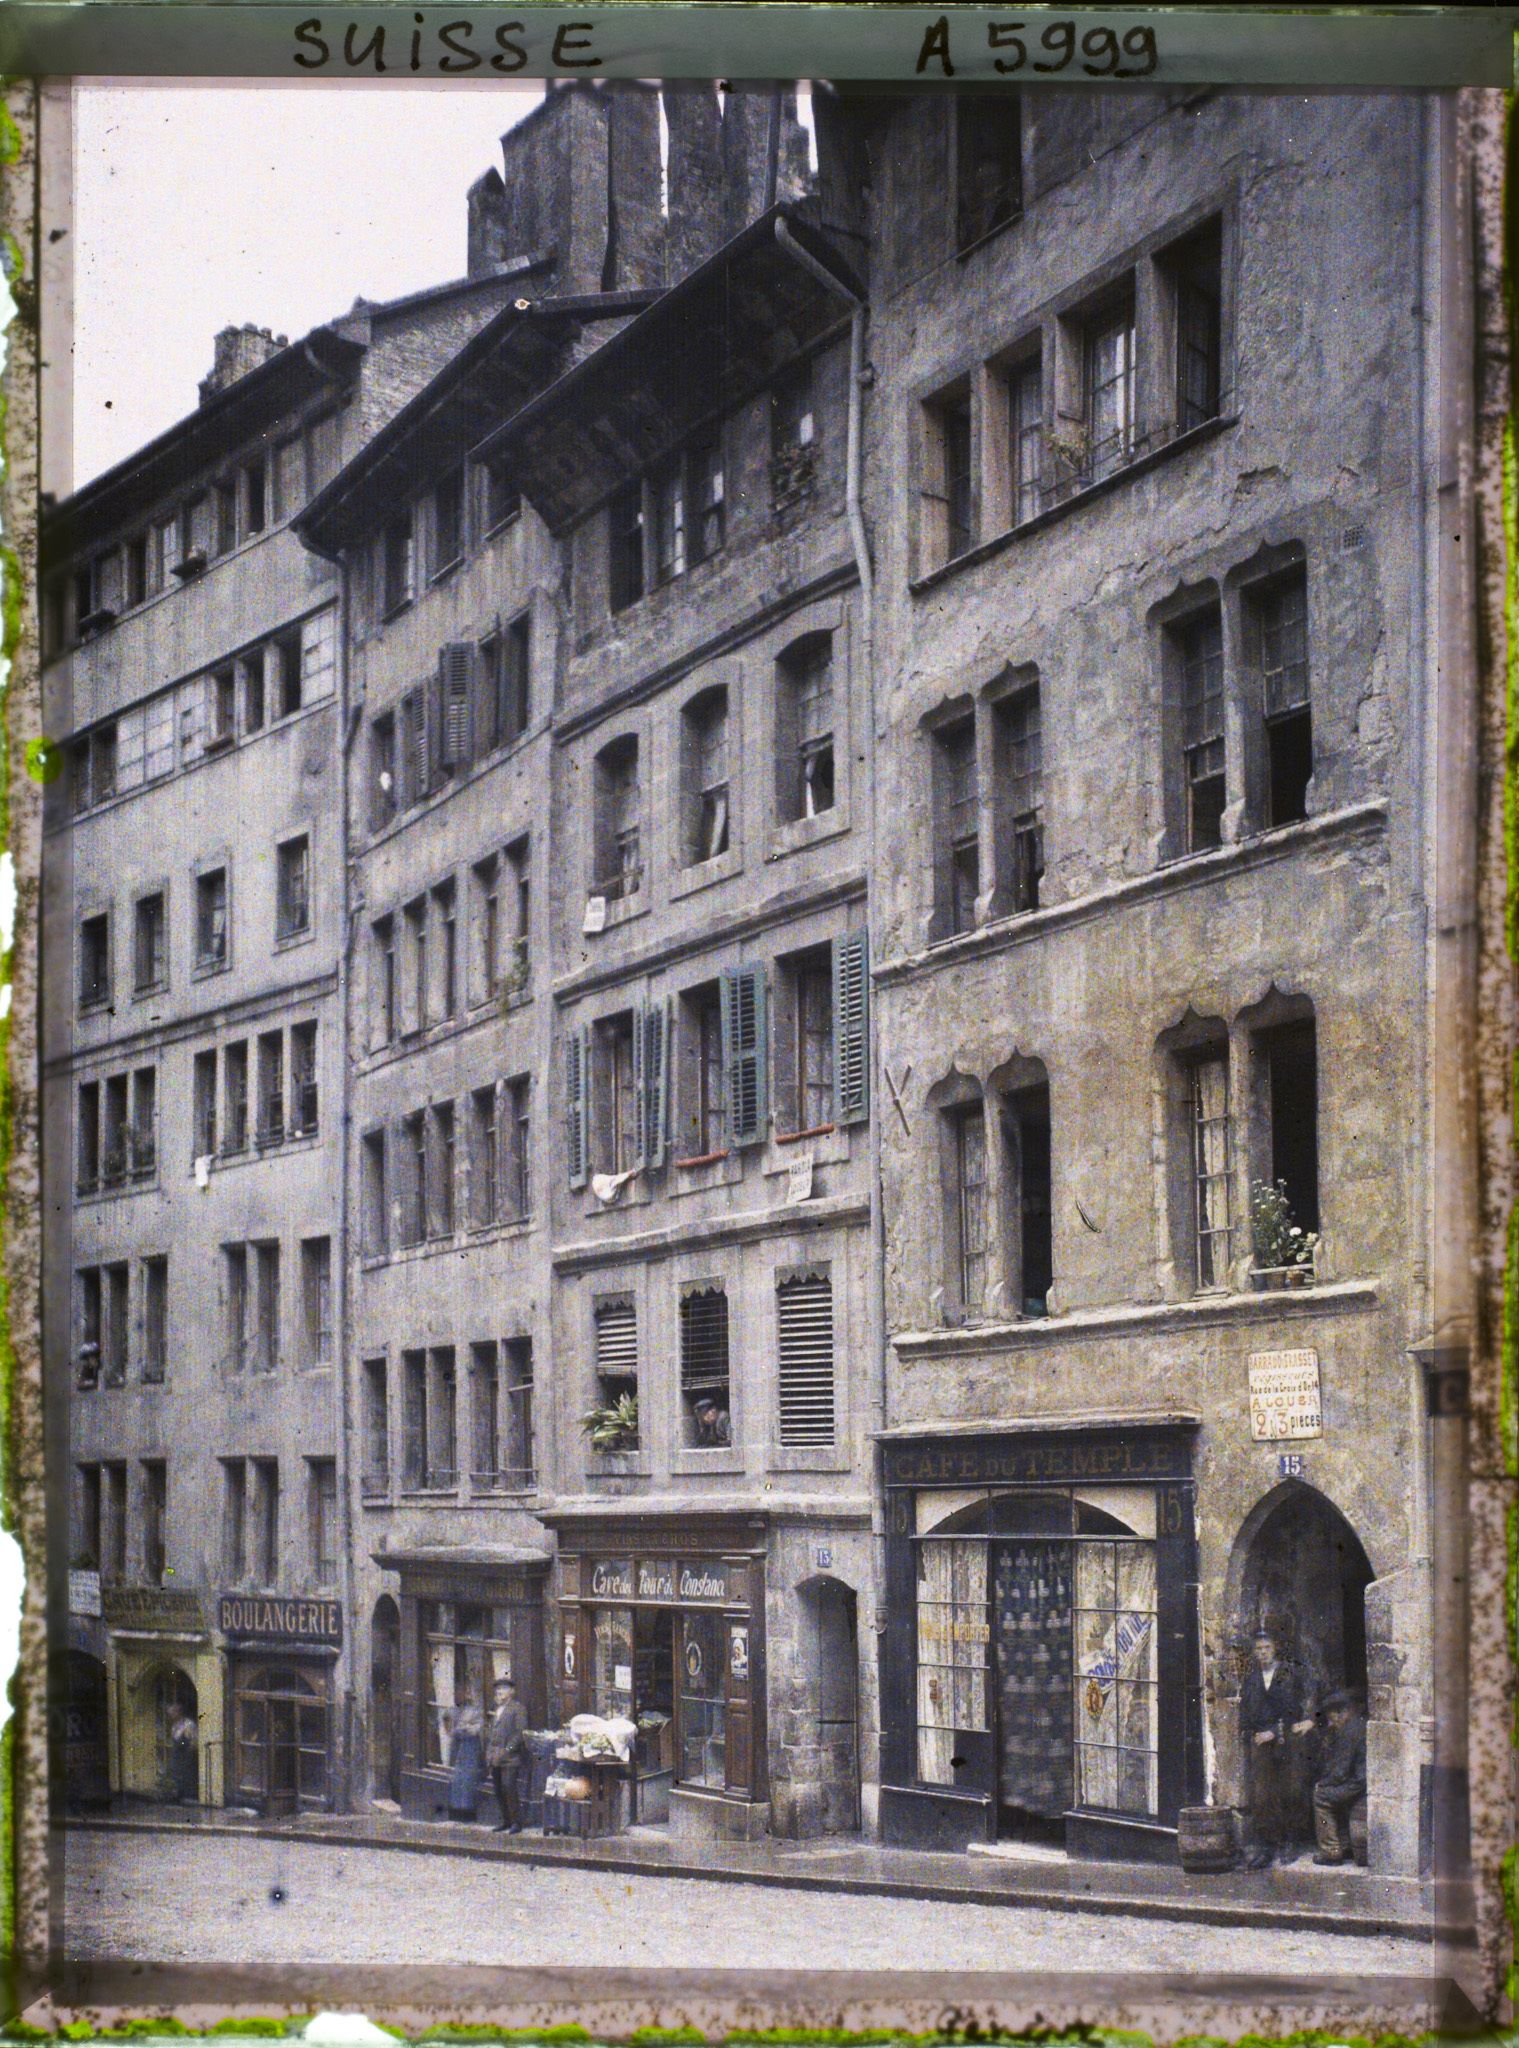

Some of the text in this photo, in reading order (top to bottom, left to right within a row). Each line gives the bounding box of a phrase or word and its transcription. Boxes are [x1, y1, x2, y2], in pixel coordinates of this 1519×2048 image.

[985, 1457, 1015, 1477] DU
[1021, 1444, 1173, 1475] TEMPLE
[1283, 1456, 1300, 1475] 15
[1158, 1489, 1181, 1533] 15
[222, 1600, 338, 1635] BOULANGERIE
